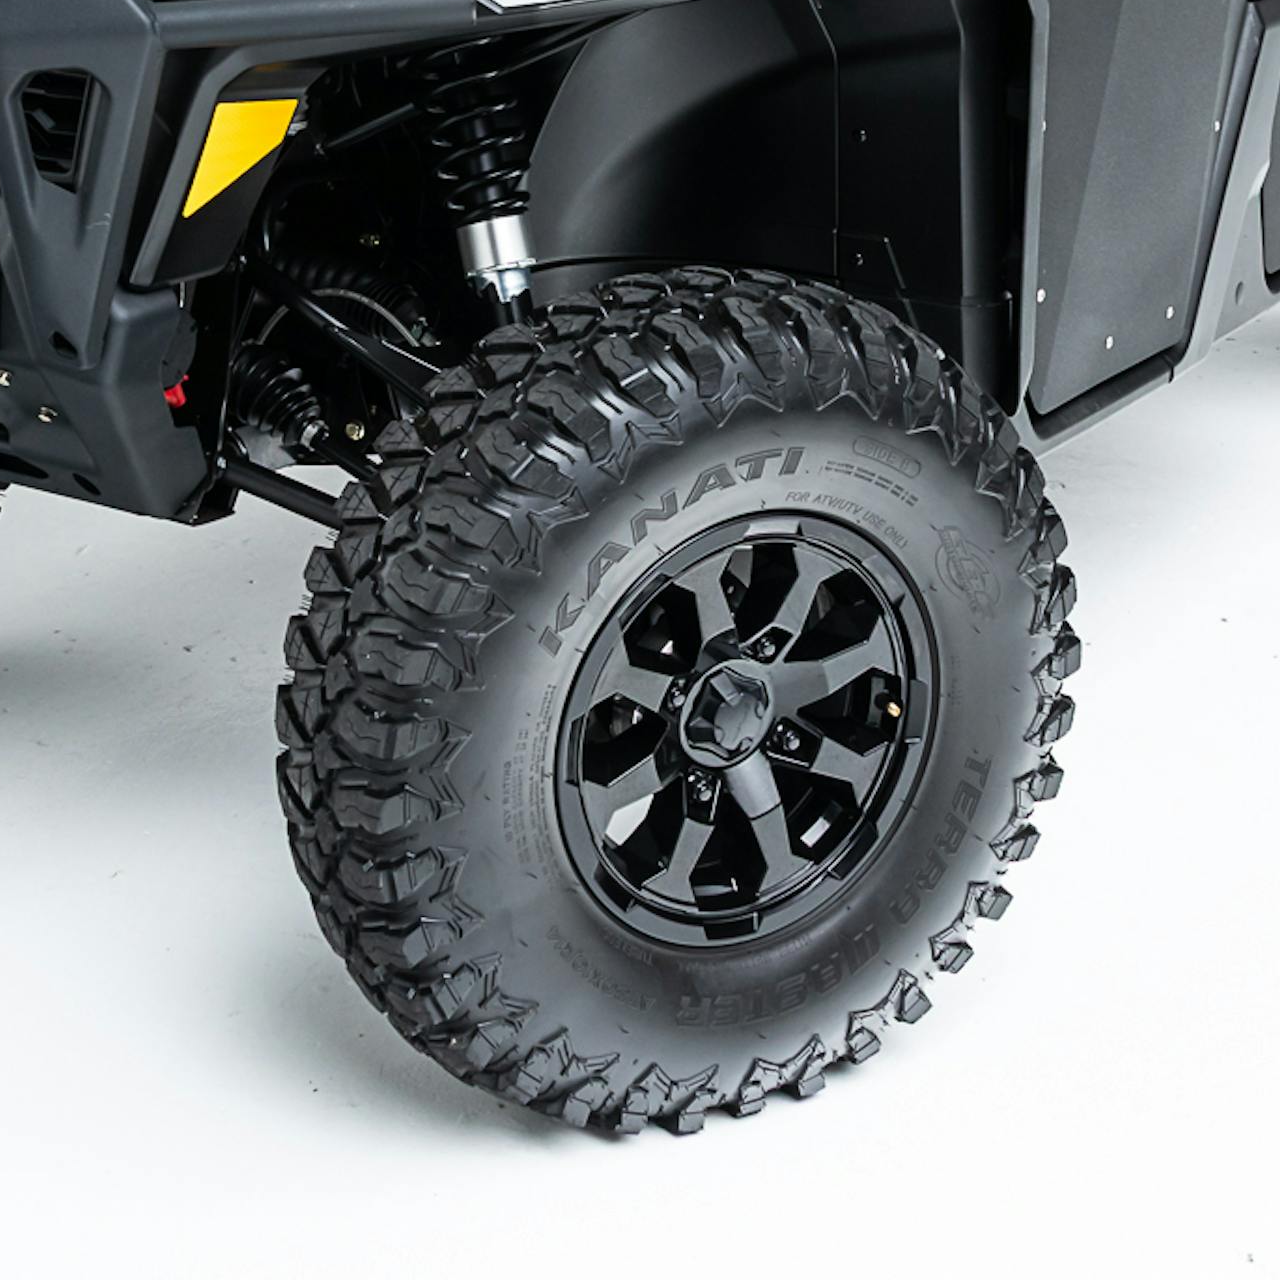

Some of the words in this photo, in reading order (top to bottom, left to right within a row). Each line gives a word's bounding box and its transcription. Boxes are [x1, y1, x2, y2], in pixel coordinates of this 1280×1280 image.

[538, 447, 805, 656] KANATI
[785, 491, 810, 503] FOR
[813, 494, 863, 516] ATV/UTV
[862, 509, 884, 529] USE
[889, 757, 991, 923] TERRA
